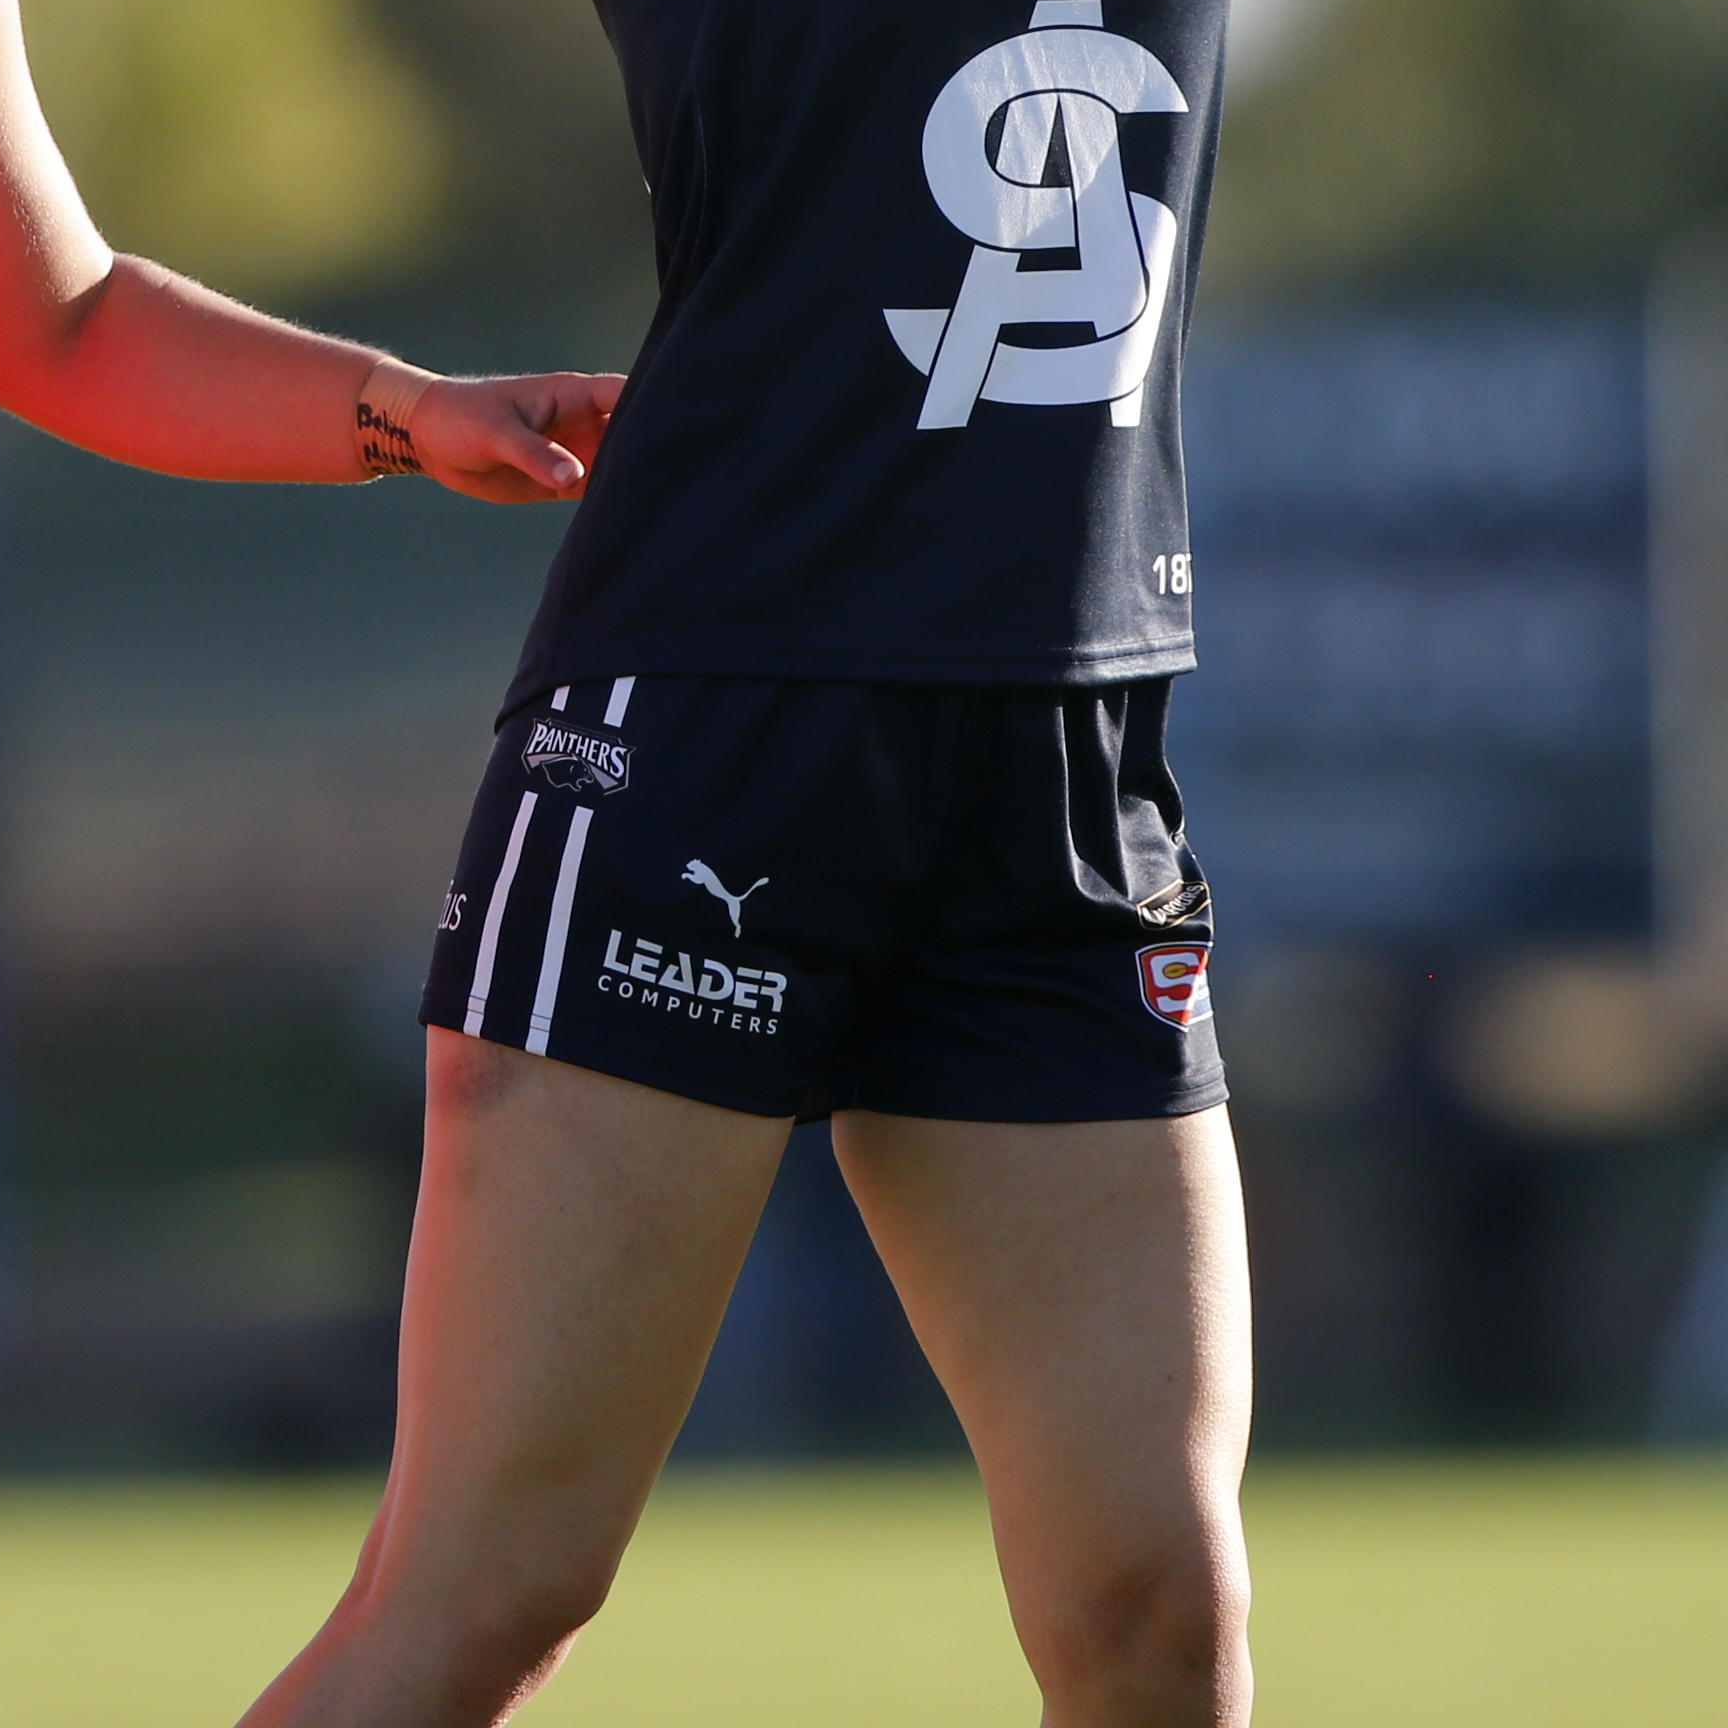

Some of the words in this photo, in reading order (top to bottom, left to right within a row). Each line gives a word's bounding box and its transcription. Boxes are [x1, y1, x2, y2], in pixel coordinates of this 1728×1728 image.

[527, 723, 628, 778] PANTHERS
[602, 929, 788, 1012] LEADER
[596, 974, 779, 1035] COMPUTERS
